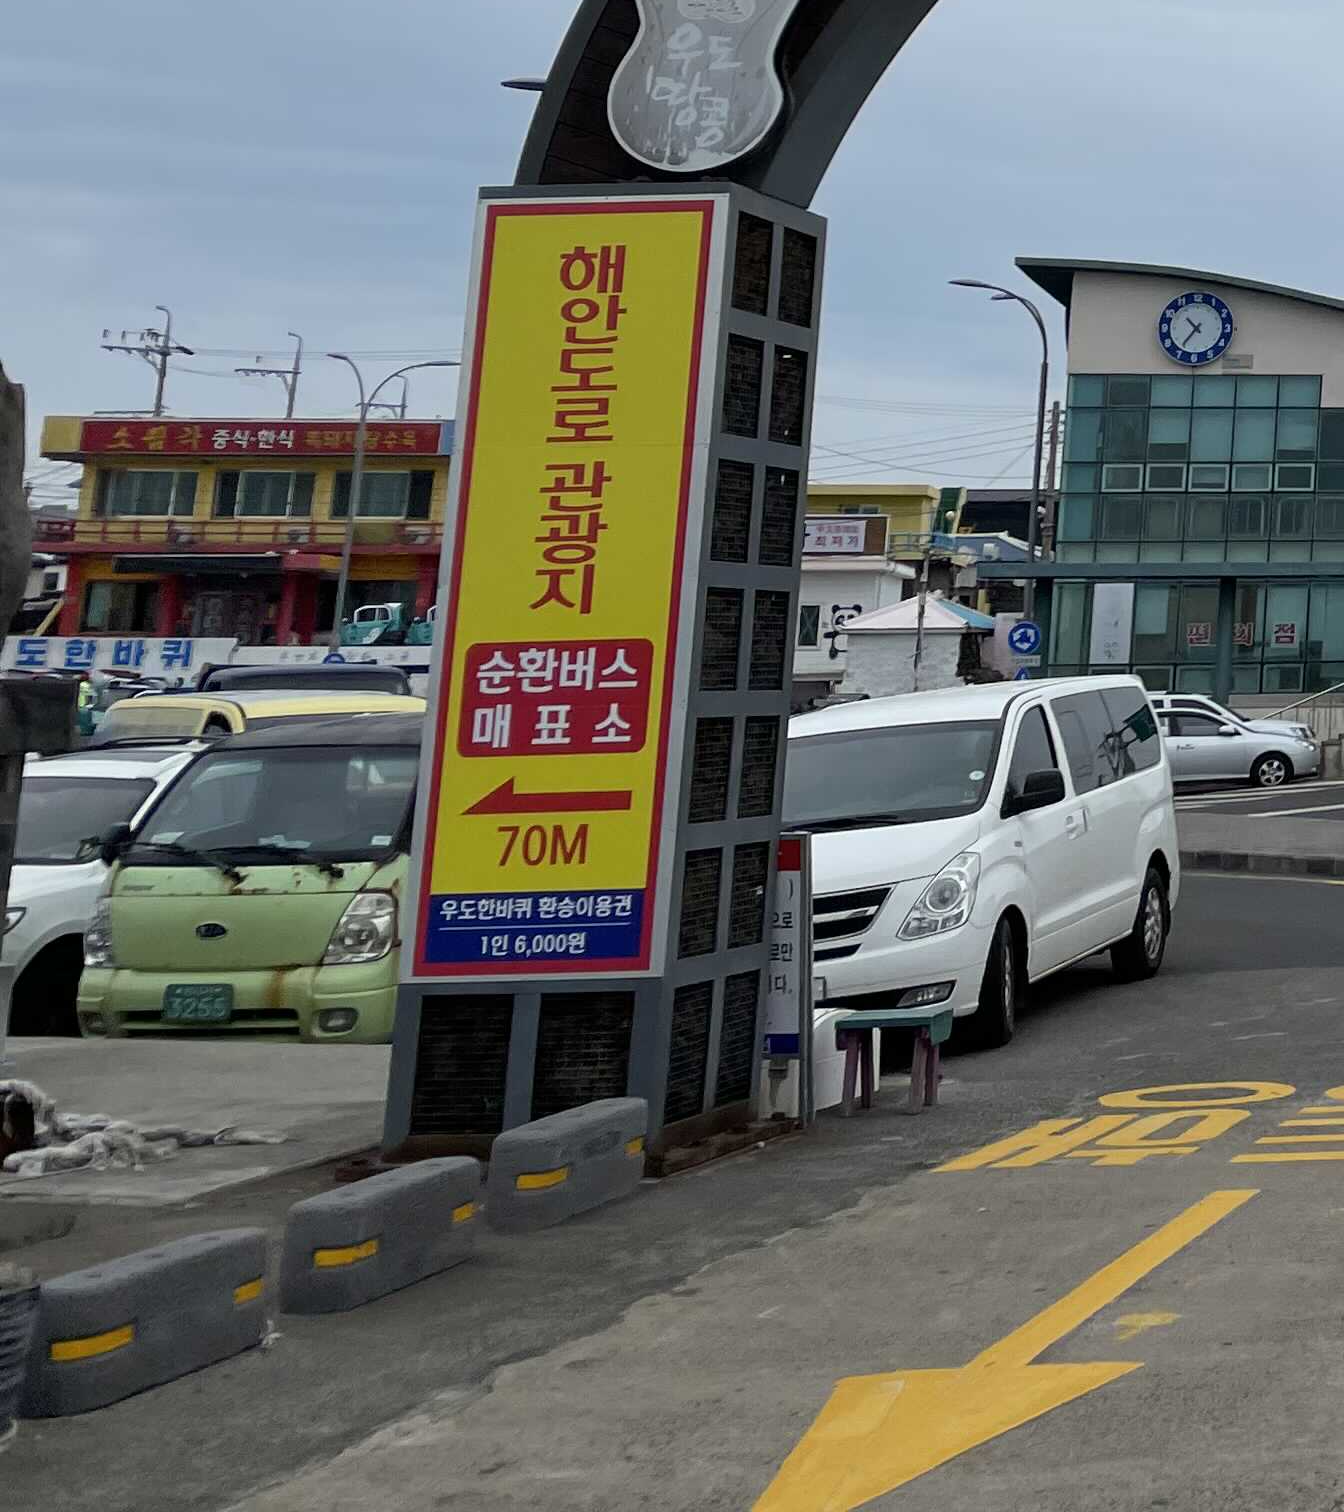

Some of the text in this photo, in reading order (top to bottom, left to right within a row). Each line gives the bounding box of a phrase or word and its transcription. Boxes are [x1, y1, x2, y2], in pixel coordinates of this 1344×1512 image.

[529, 244, 628, 615] 해안도로 관광지
[15, 638, 193, 670] 도한바퀴
[475, 647, 639, 695] 순환버스
[471, 702, 632, 749] 매표소
[497, 823, 589, 867] 70M
[439, 895, 633, 921] 우도한바퀴 환승이용권
[480, 931, 587, 958] 1인 6,000원
